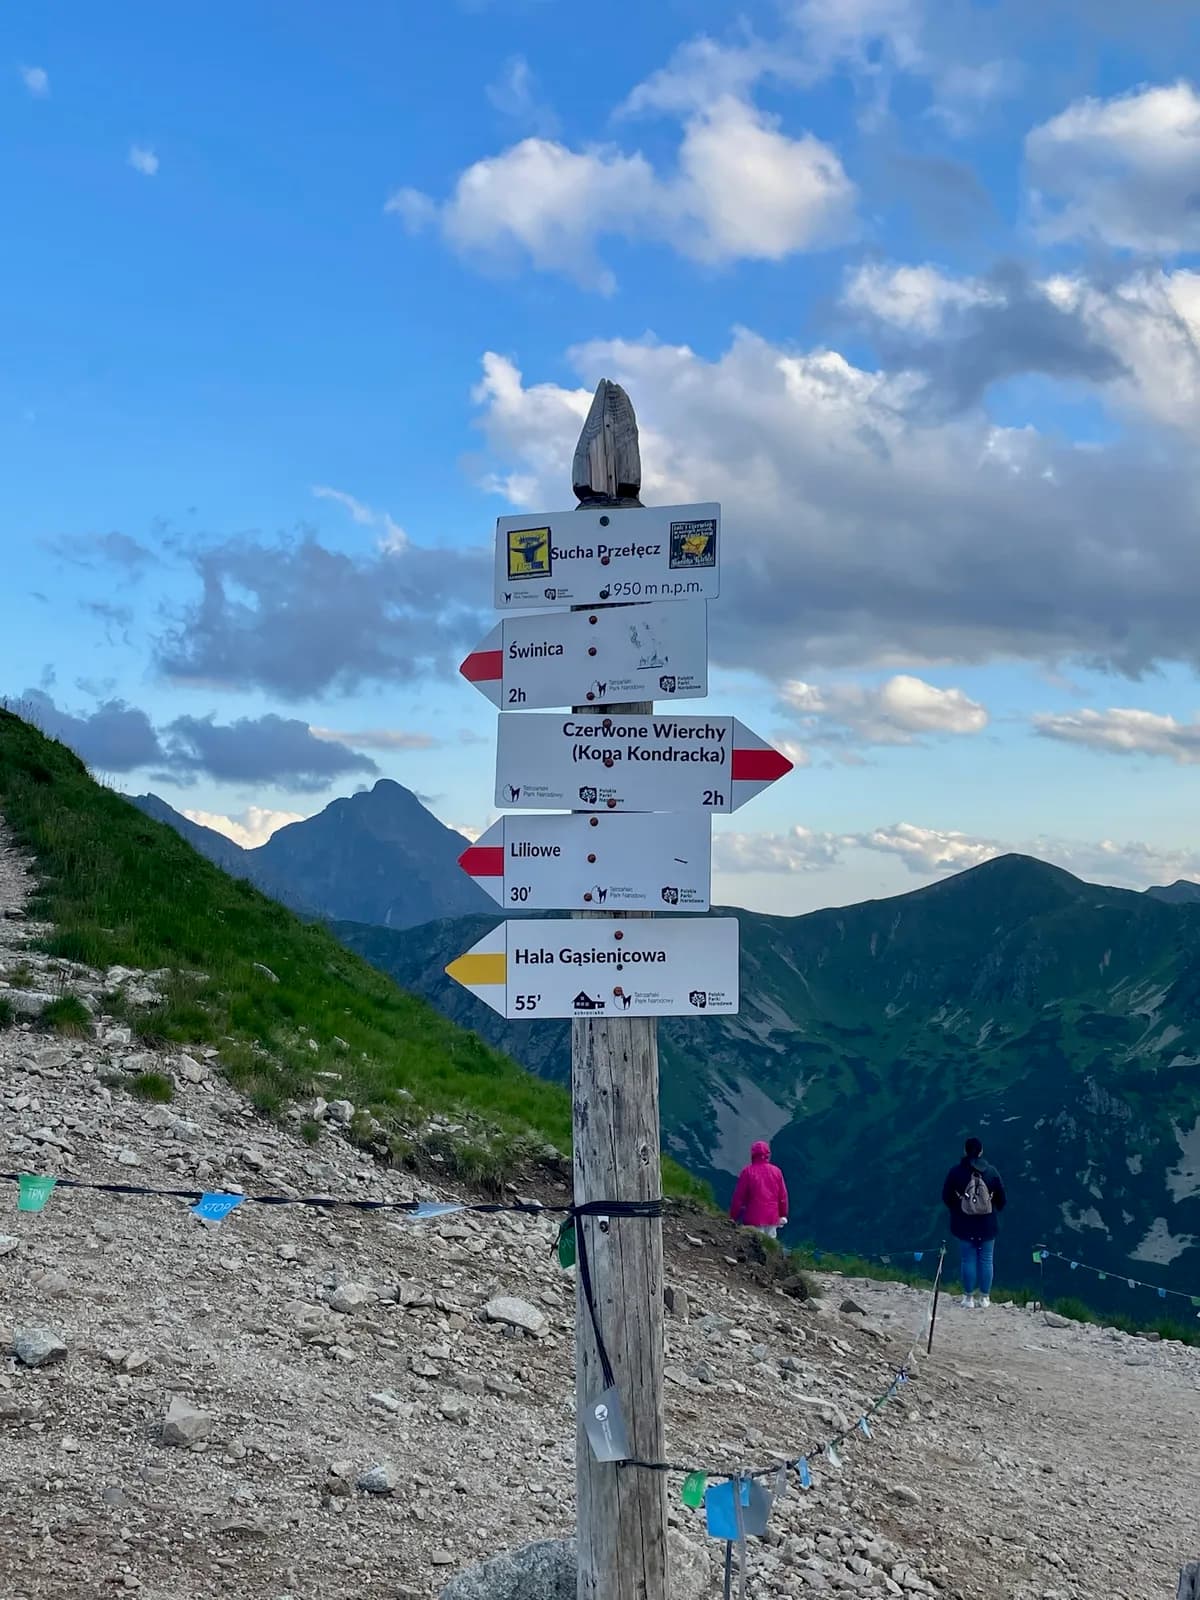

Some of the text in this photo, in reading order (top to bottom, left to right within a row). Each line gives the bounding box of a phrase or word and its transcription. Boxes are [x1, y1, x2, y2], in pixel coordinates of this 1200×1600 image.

[550, 543, 661, 560] Sucha Przełęcz
[604, 582, 704, 597] 1950 m n.p.m.
[509, 640, 564, 659] Świnica
[509, 688, 526, 703] 2h
[563, 721, 726, 742] Czerwone Wierchy
[572, 744, 726, 765] (Kopa Kondracka)
[702, 790, 724, 805] 2h
[511, 842, 561, 858] Liliowe
[510, 886, 532, 902] 30'
[515, 947, 667, 967] Hala Gąsienicowa
[201, 1202, 232, 1213] STOP
